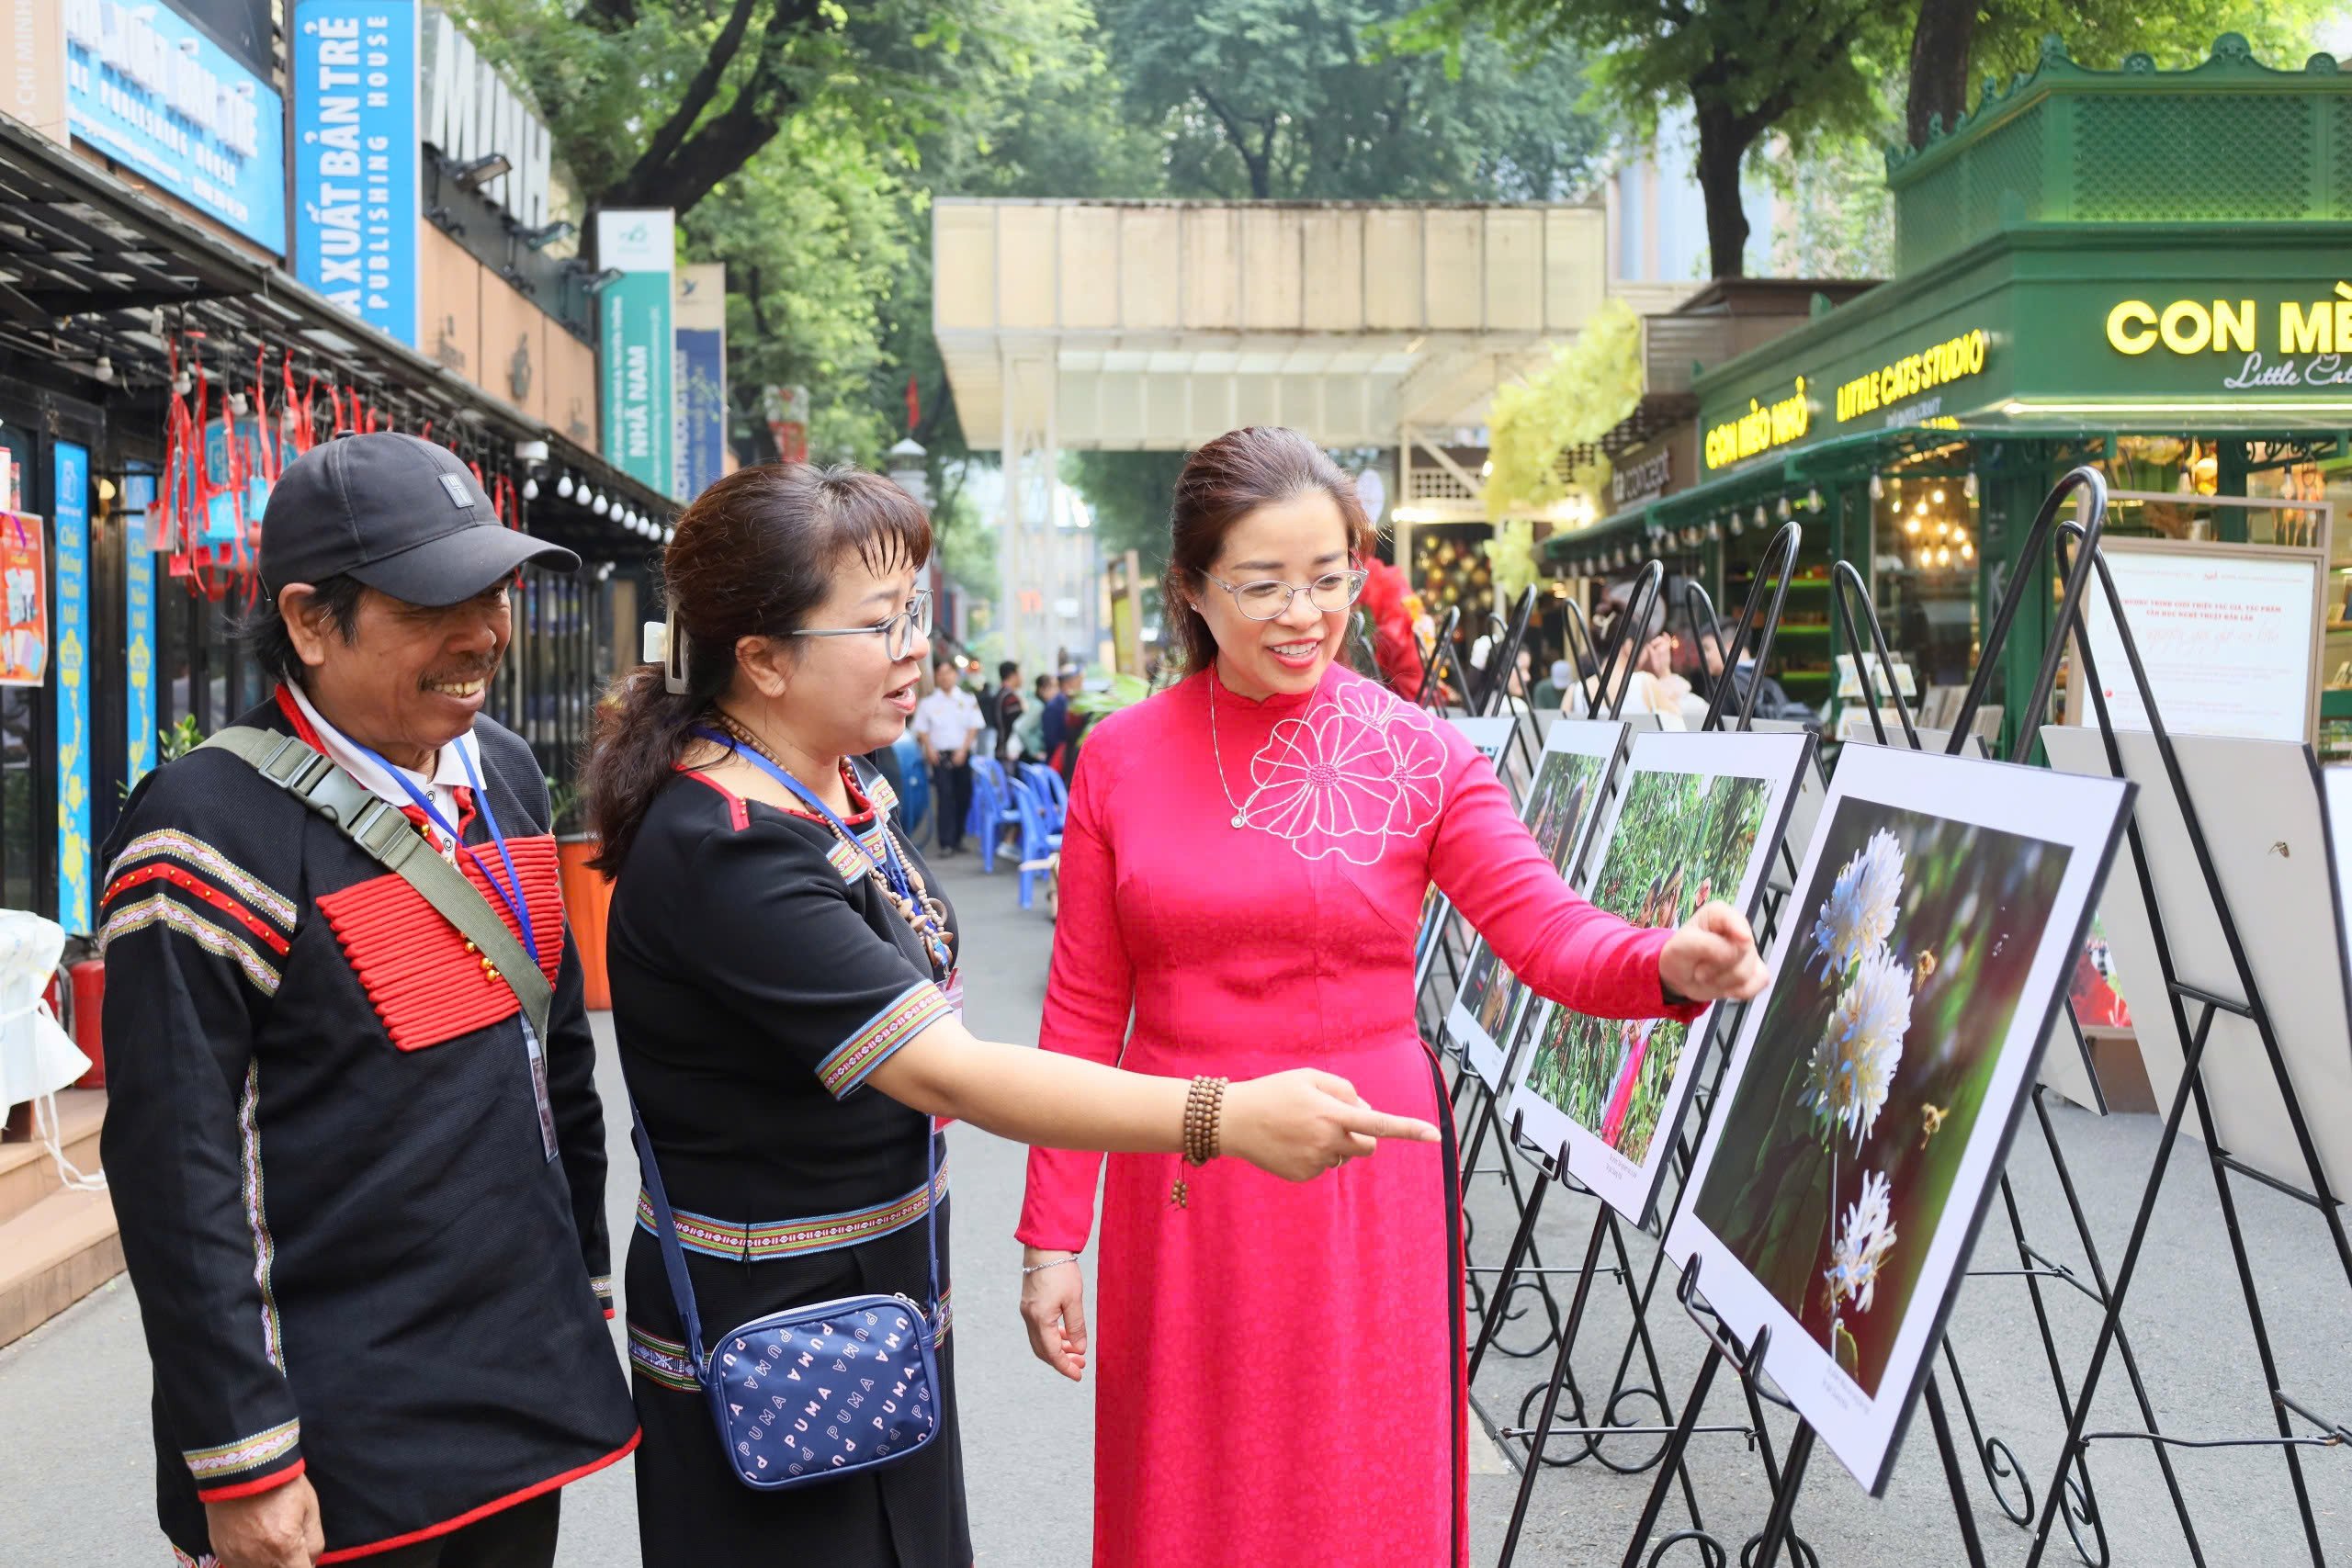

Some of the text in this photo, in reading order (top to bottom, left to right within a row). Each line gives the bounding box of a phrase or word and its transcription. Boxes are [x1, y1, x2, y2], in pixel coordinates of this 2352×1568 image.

[304, 17, 360, 90] TRẺ
[304, 96, 361, 177] BẢN
[368, 15, 390, 310] PUBLISHING HOUSE
[306, 183, 361, 283] XUẤT
[2107, 299, 2256, 355] CON
[628, 346, 649, 401] NAM
[1837, 371, 1880, 423] LITTLE
[1880, 353, 1921, 407] CATS
[1920, 328, 1985, 390] STUDIO
[2223, 352, 2301, 389] Little
[1705, 421, 1738, 470] CON
[743, 1328, 793, 1390] PUMA
[786, 1322, 834, 1382] PUMA
[831, 1311, 878, 1373] PUMA
[738, 1395, 787, 1457] PUMA
[783, 1386, 832, 1449] PUMA
[826, 1377, 875, 1440] PUMA
[872, 1366, 916, 1430] PUMA
